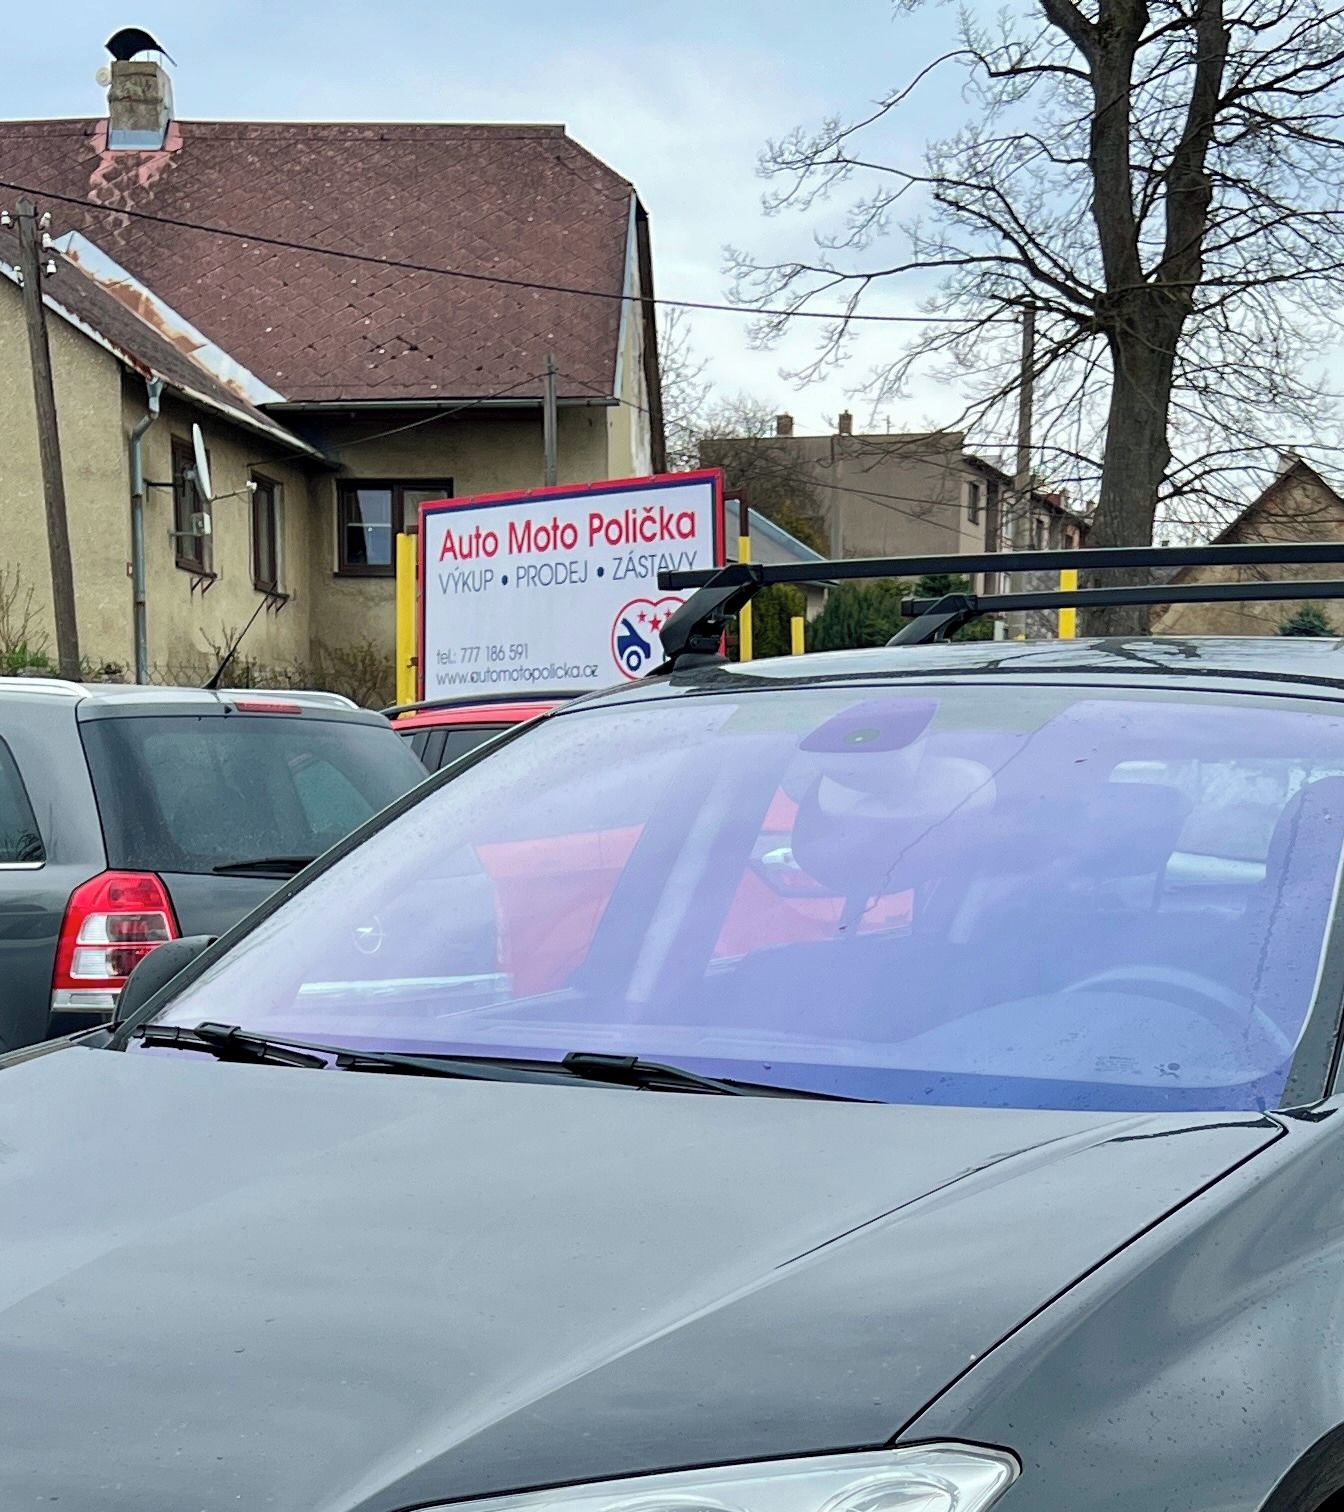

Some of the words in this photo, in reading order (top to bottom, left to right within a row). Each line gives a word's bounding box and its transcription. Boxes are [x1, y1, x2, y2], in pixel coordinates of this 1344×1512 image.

[439, 526, 499, 561] Auto
[508, 517, 578, 555] Moto
[589, 506, 696, 547] Polička
[438, 565, 494, 595] VÝKUP
[516, 560, 588, 588] PRODEJ
[460, 646, 481, 664] 777
[485, 644, 506, 662] 186
[508, 643, 529, 660] 591
[436, 662, 599, 685] www.automotopolicka.cz
